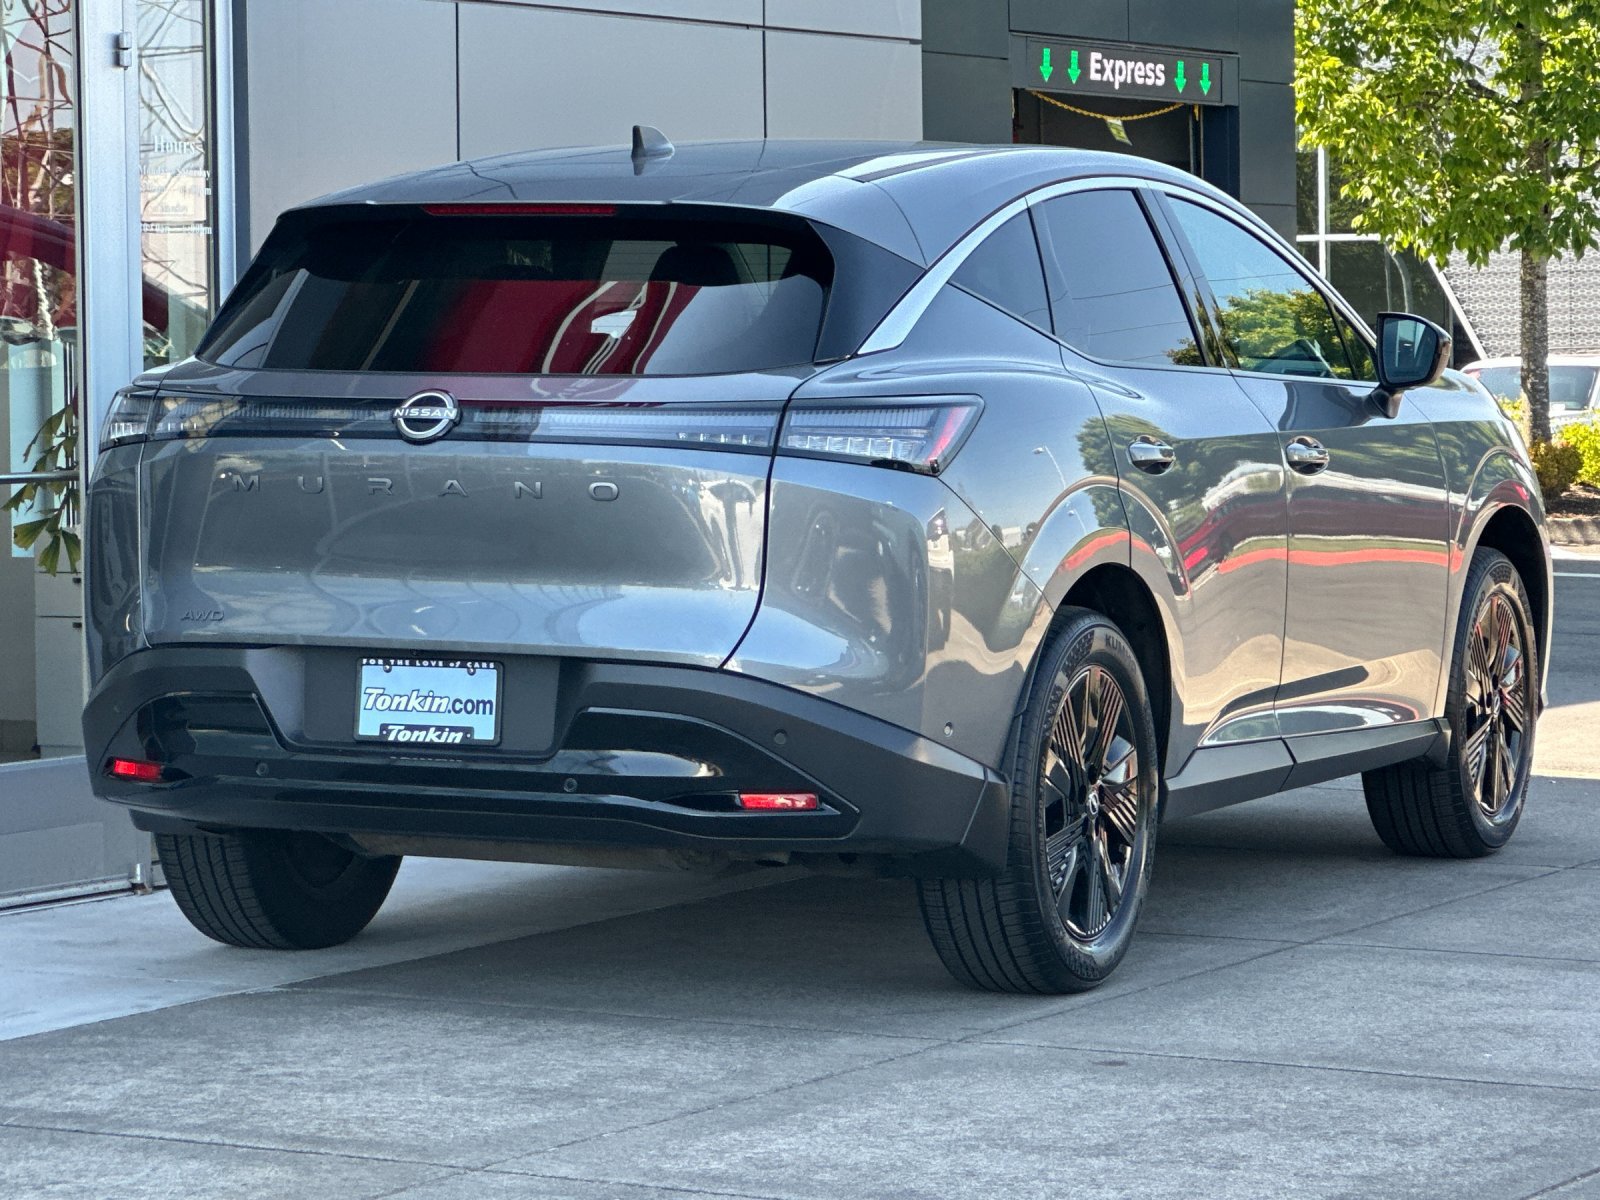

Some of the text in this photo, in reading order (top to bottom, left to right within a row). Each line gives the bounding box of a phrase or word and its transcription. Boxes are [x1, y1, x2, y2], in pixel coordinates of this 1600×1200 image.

[1089, 51, 1166, 90] Express
[154, 136, 195, 154] Hours
[394, 408, 457, 419] NISSAN
[231, 474, 620, 502] MURANO
[181, 609, 225, 621] AWD
[362, 658, 384, 666] FOR
[390, 659, 410, 667] THE
[416, 660, 443, 668] LOVE
[364, 687, 493, 715] Tonkin.com
[387, 725, 463, 743] Tonkin
